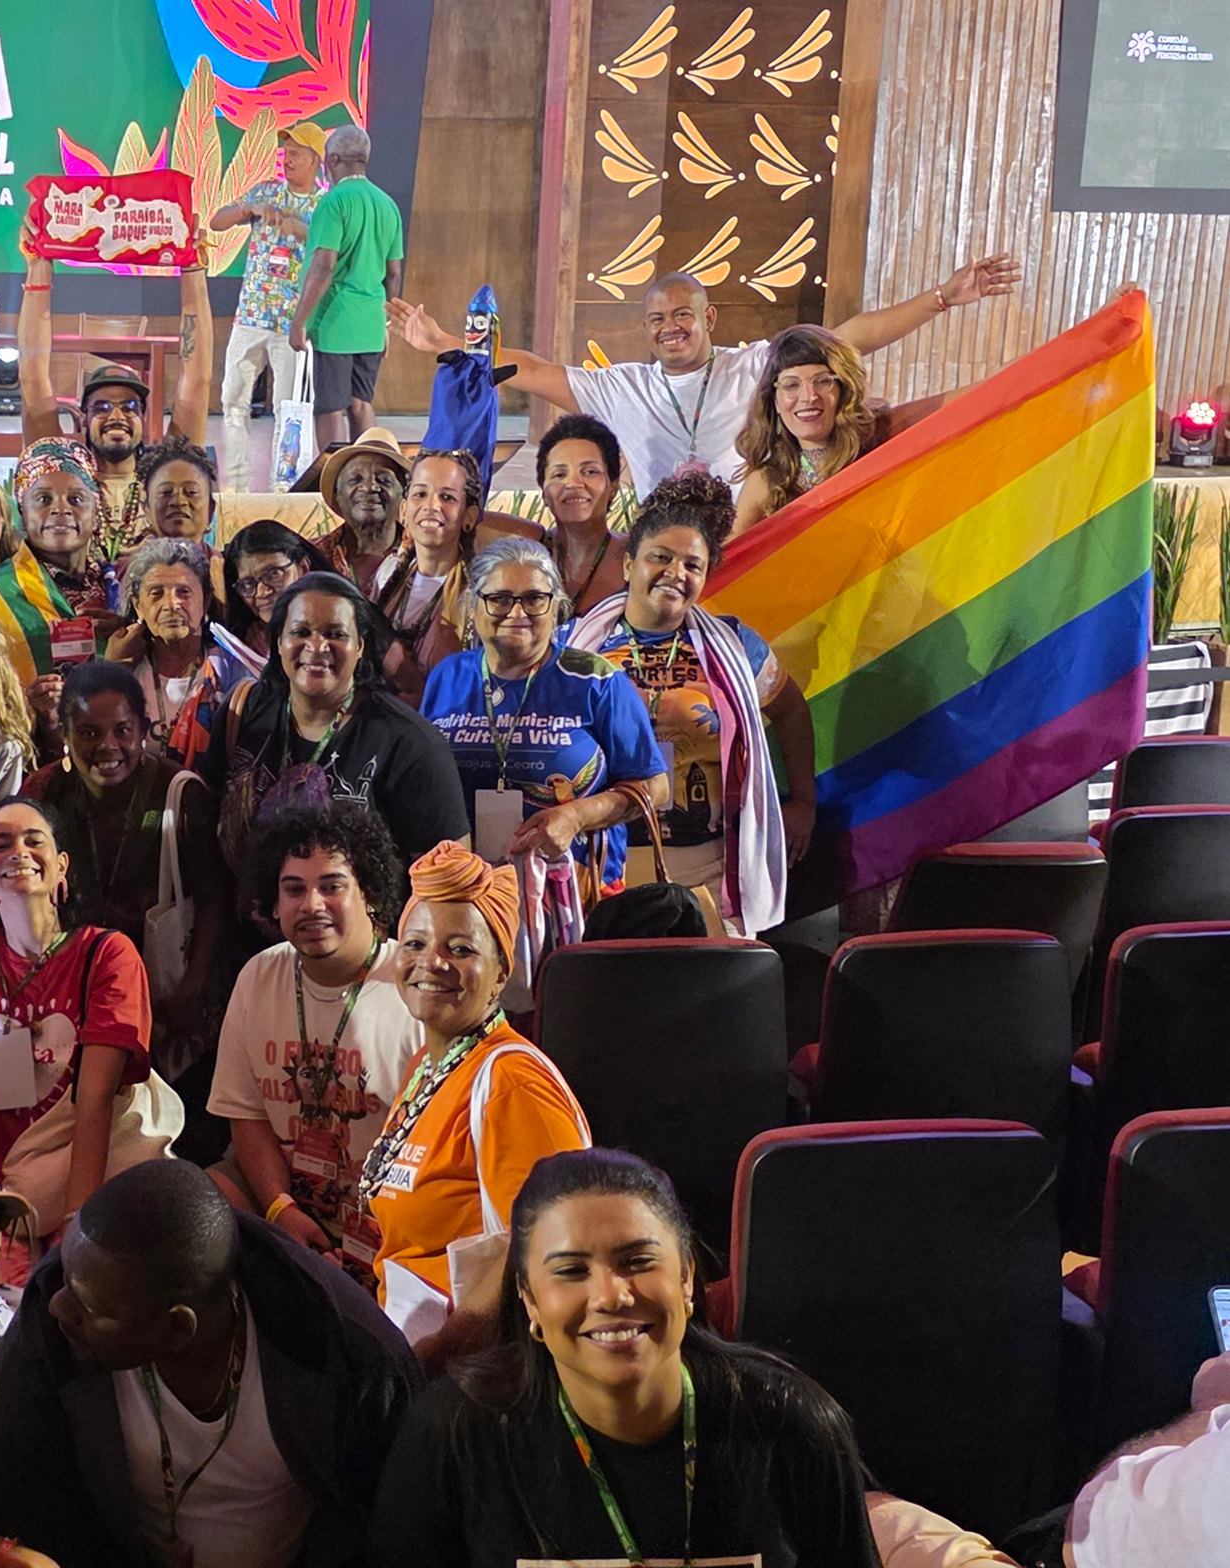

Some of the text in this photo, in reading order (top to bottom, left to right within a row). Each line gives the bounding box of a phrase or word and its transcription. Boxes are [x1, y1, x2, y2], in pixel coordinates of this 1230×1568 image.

[1186, 52, 1214, 61] CULTURA
[53, 200, 83, 216] MARA
[114, 208, 165, 224] PARAÍBA
[112, 225, 148, 242] BAQUE
[432, 712, 582, 732] Política Municipal
[528, 729, 573, 746] Viva
[265, 1040, 277, 1066] O
